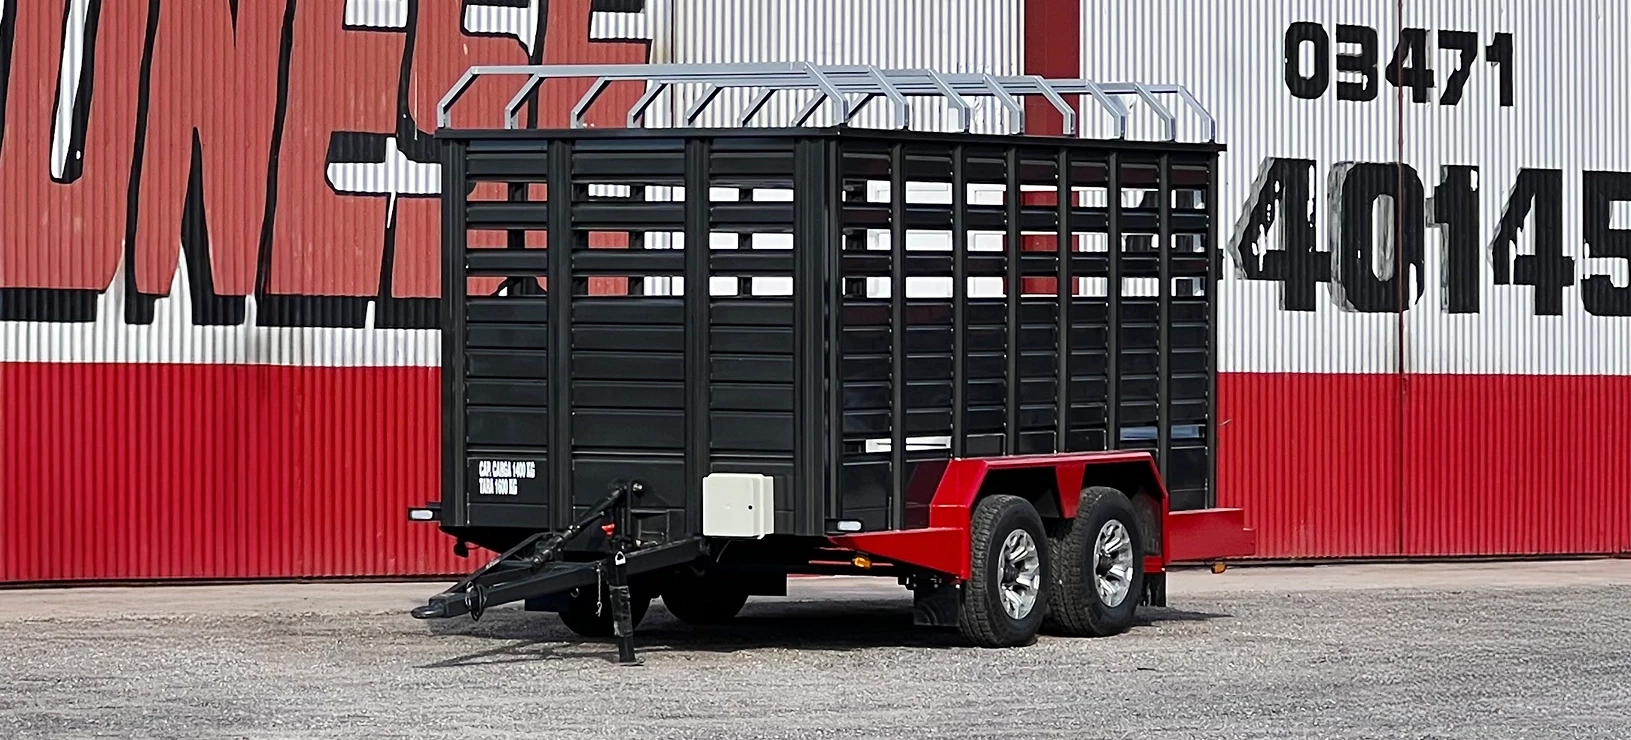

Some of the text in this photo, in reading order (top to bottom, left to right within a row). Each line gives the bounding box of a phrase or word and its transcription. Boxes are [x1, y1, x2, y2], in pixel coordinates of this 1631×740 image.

[1284, 21, 1514, 107] 03471
[1214, 156, 1631, 317] 40145
[492, 460, 512, 478] CARGA
[526, 461, 536, 479] KG
[509, 478, 518, 495] KG
